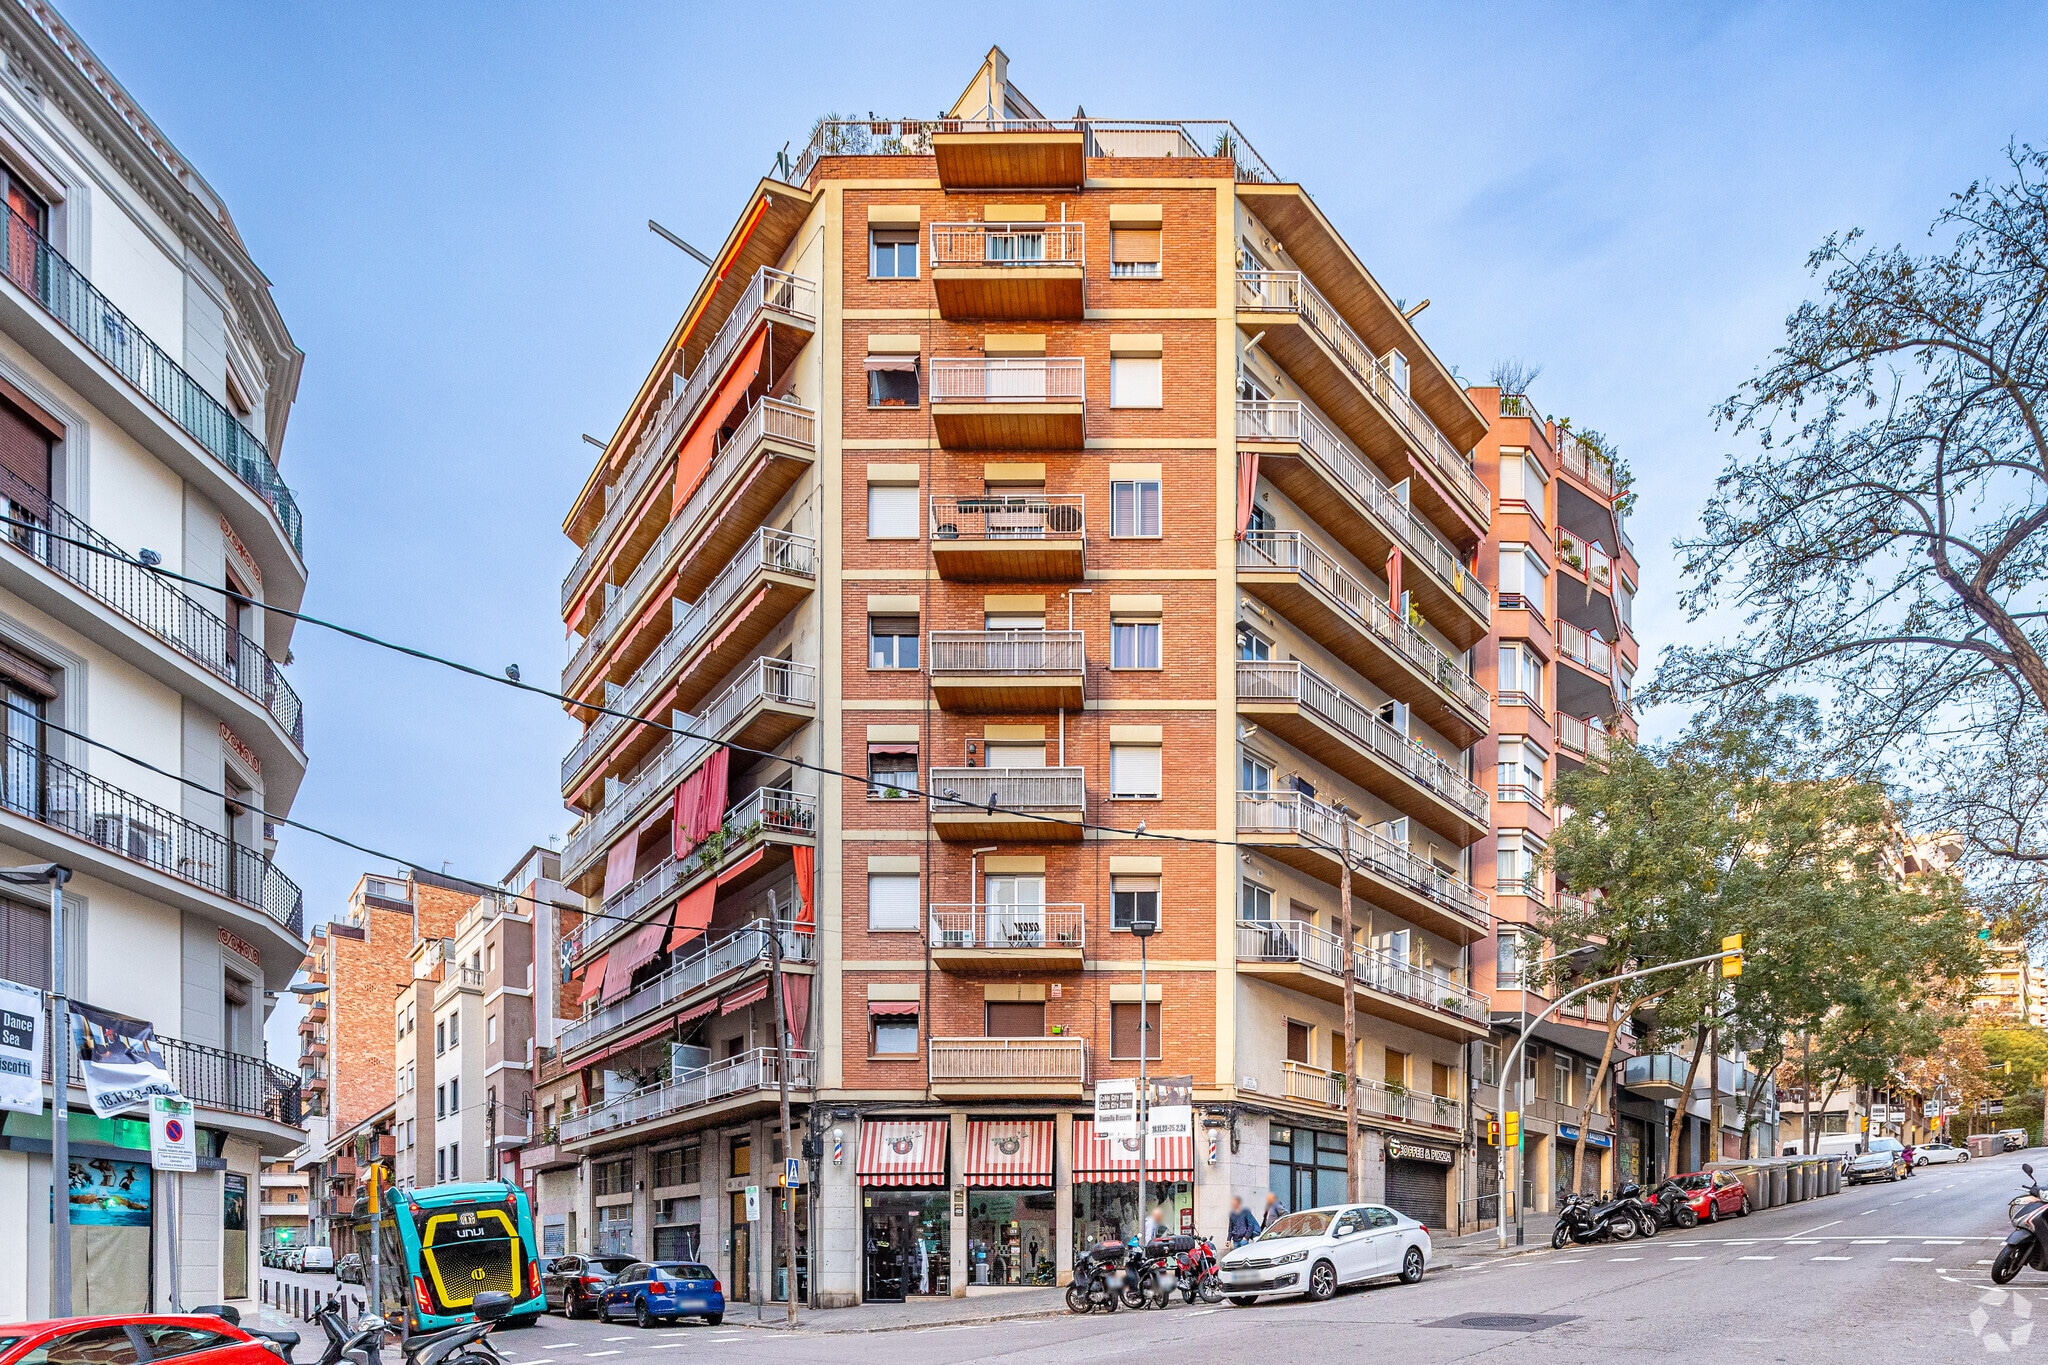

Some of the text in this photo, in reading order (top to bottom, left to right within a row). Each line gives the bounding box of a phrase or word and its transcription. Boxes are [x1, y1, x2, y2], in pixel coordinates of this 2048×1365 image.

[3, 1012, 33, 1032] Dance
[2, 1029, 20, 1046] Sea
[1425, 1148, 1431, 1159] &
[1431, 1149, 1452, 1163] PIZZA
